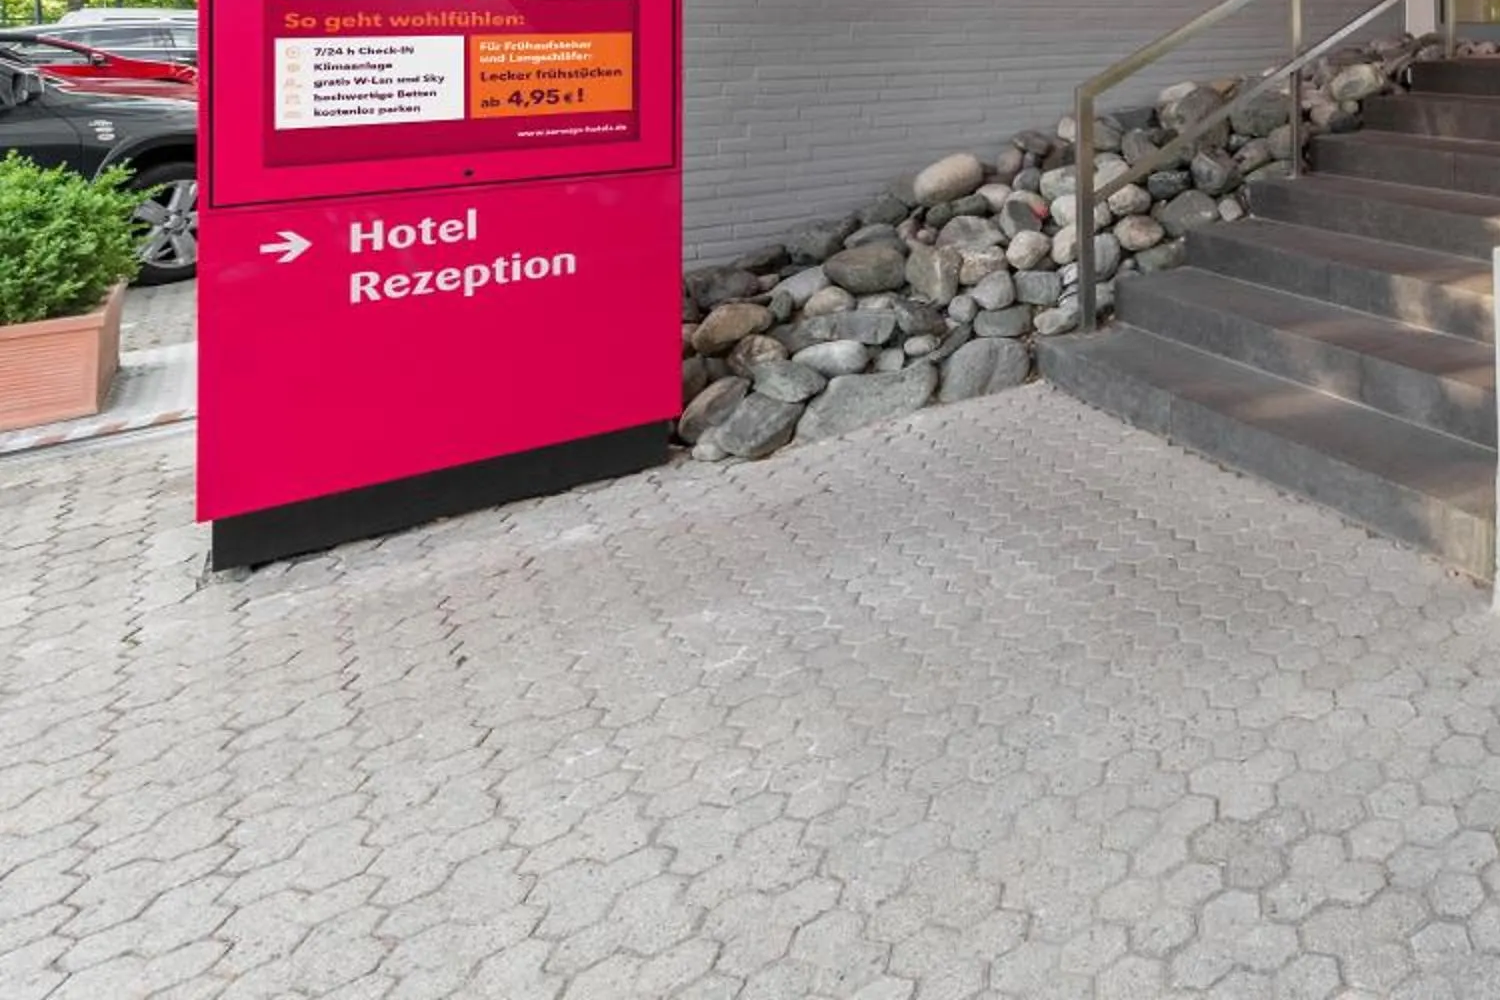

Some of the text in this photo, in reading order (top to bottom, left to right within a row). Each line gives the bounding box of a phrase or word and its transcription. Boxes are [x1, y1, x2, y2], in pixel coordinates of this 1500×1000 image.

[284, 10, 526, 33] So geht wohlfühlen:
[314, 45, 415, 57] 7/24 h Check-IN
[480, 41, 500, 51] Für
[480, 53, 505, 63] und
[313, 62, 393, 73] Klimaanlage
[313, 73, 445, 89] gratis W-Lan und Sky
[480, 67, 623, 82] Lecker frühstücken
[313, 89, 437, 102] hochwertige Betten
[481, 97, 500, 108] ab
[313, 104, 421, 117] kostenlos parken
[350, 208, 477, 254] Hotel
[350, 251, 576, 303] Rezeption
